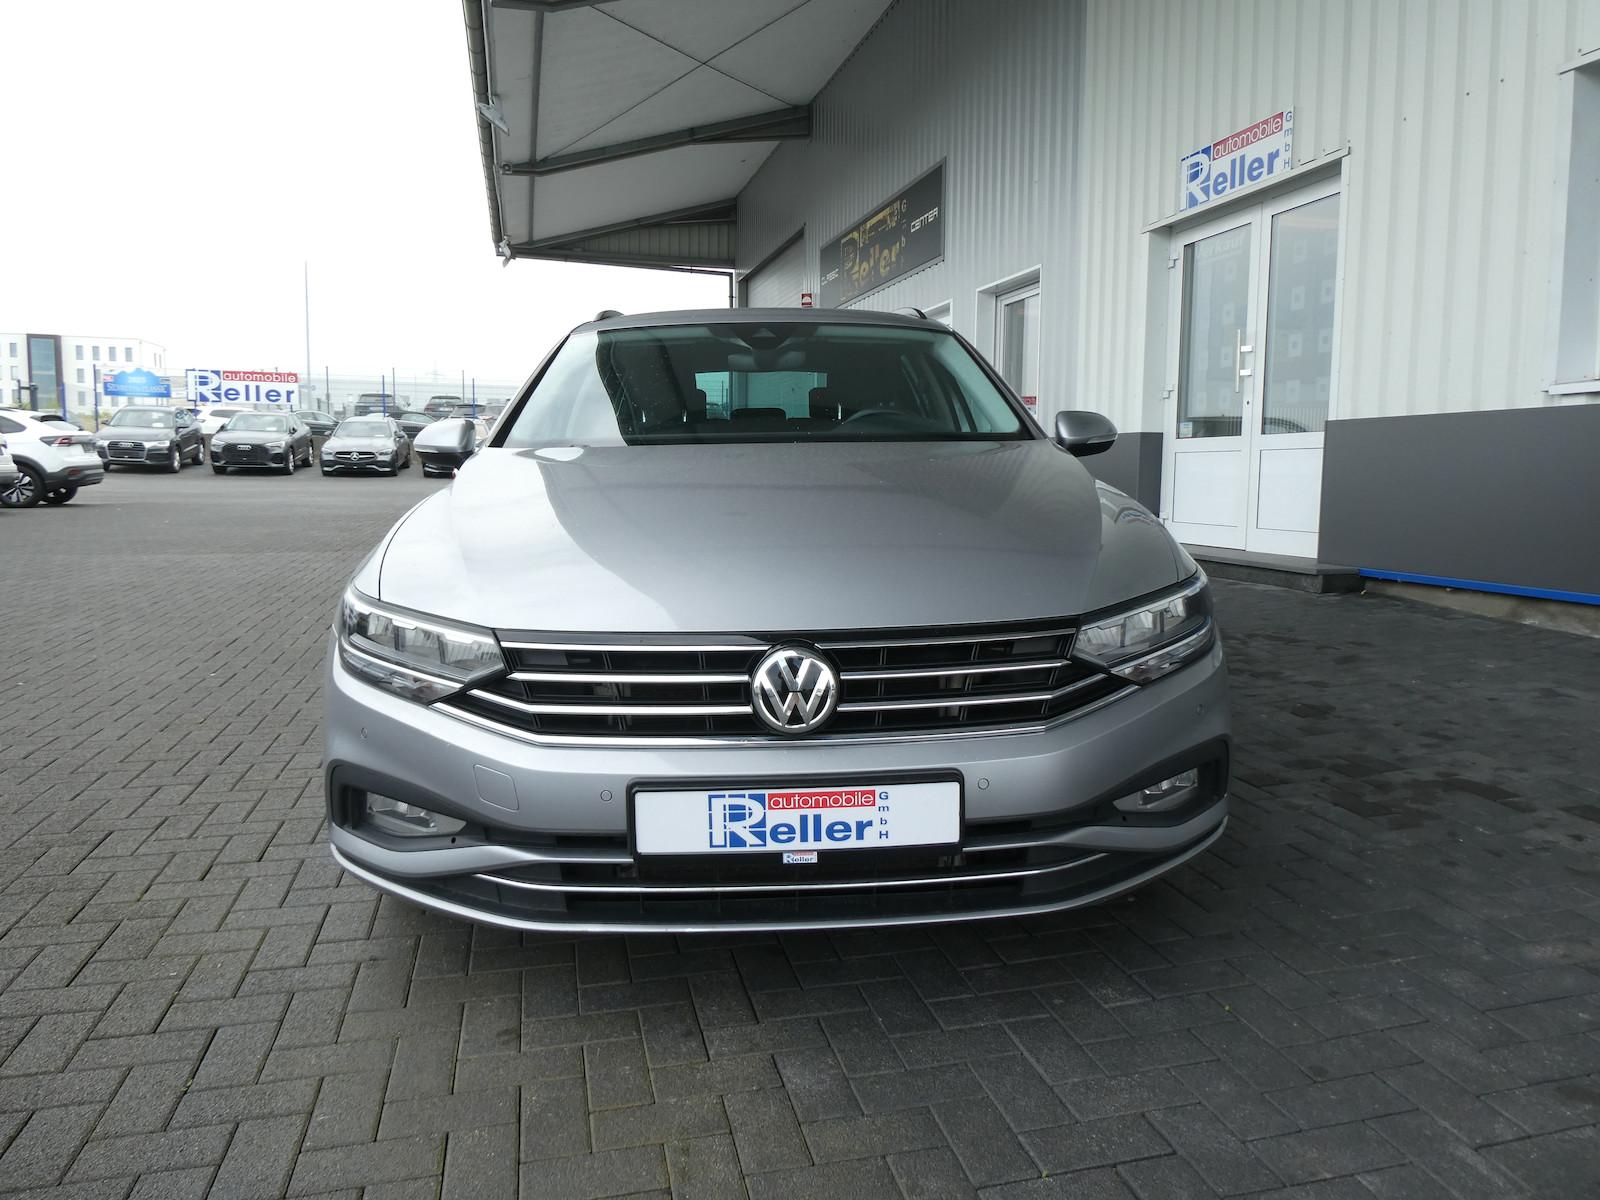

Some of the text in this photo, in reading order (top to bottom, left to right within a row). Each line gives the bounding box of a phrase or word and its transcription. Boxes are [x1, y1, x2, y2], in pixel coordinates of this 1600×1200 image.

[1213, 117, 1281, 159] automobile
[1284, 111, 1293, 169] GmbH
[223, 372, 296, 383] automobile
[708, 793, 873, 848] Reller
[770, 790, 875, 810] automobile
[878, 791, 889, 839] GmbH
